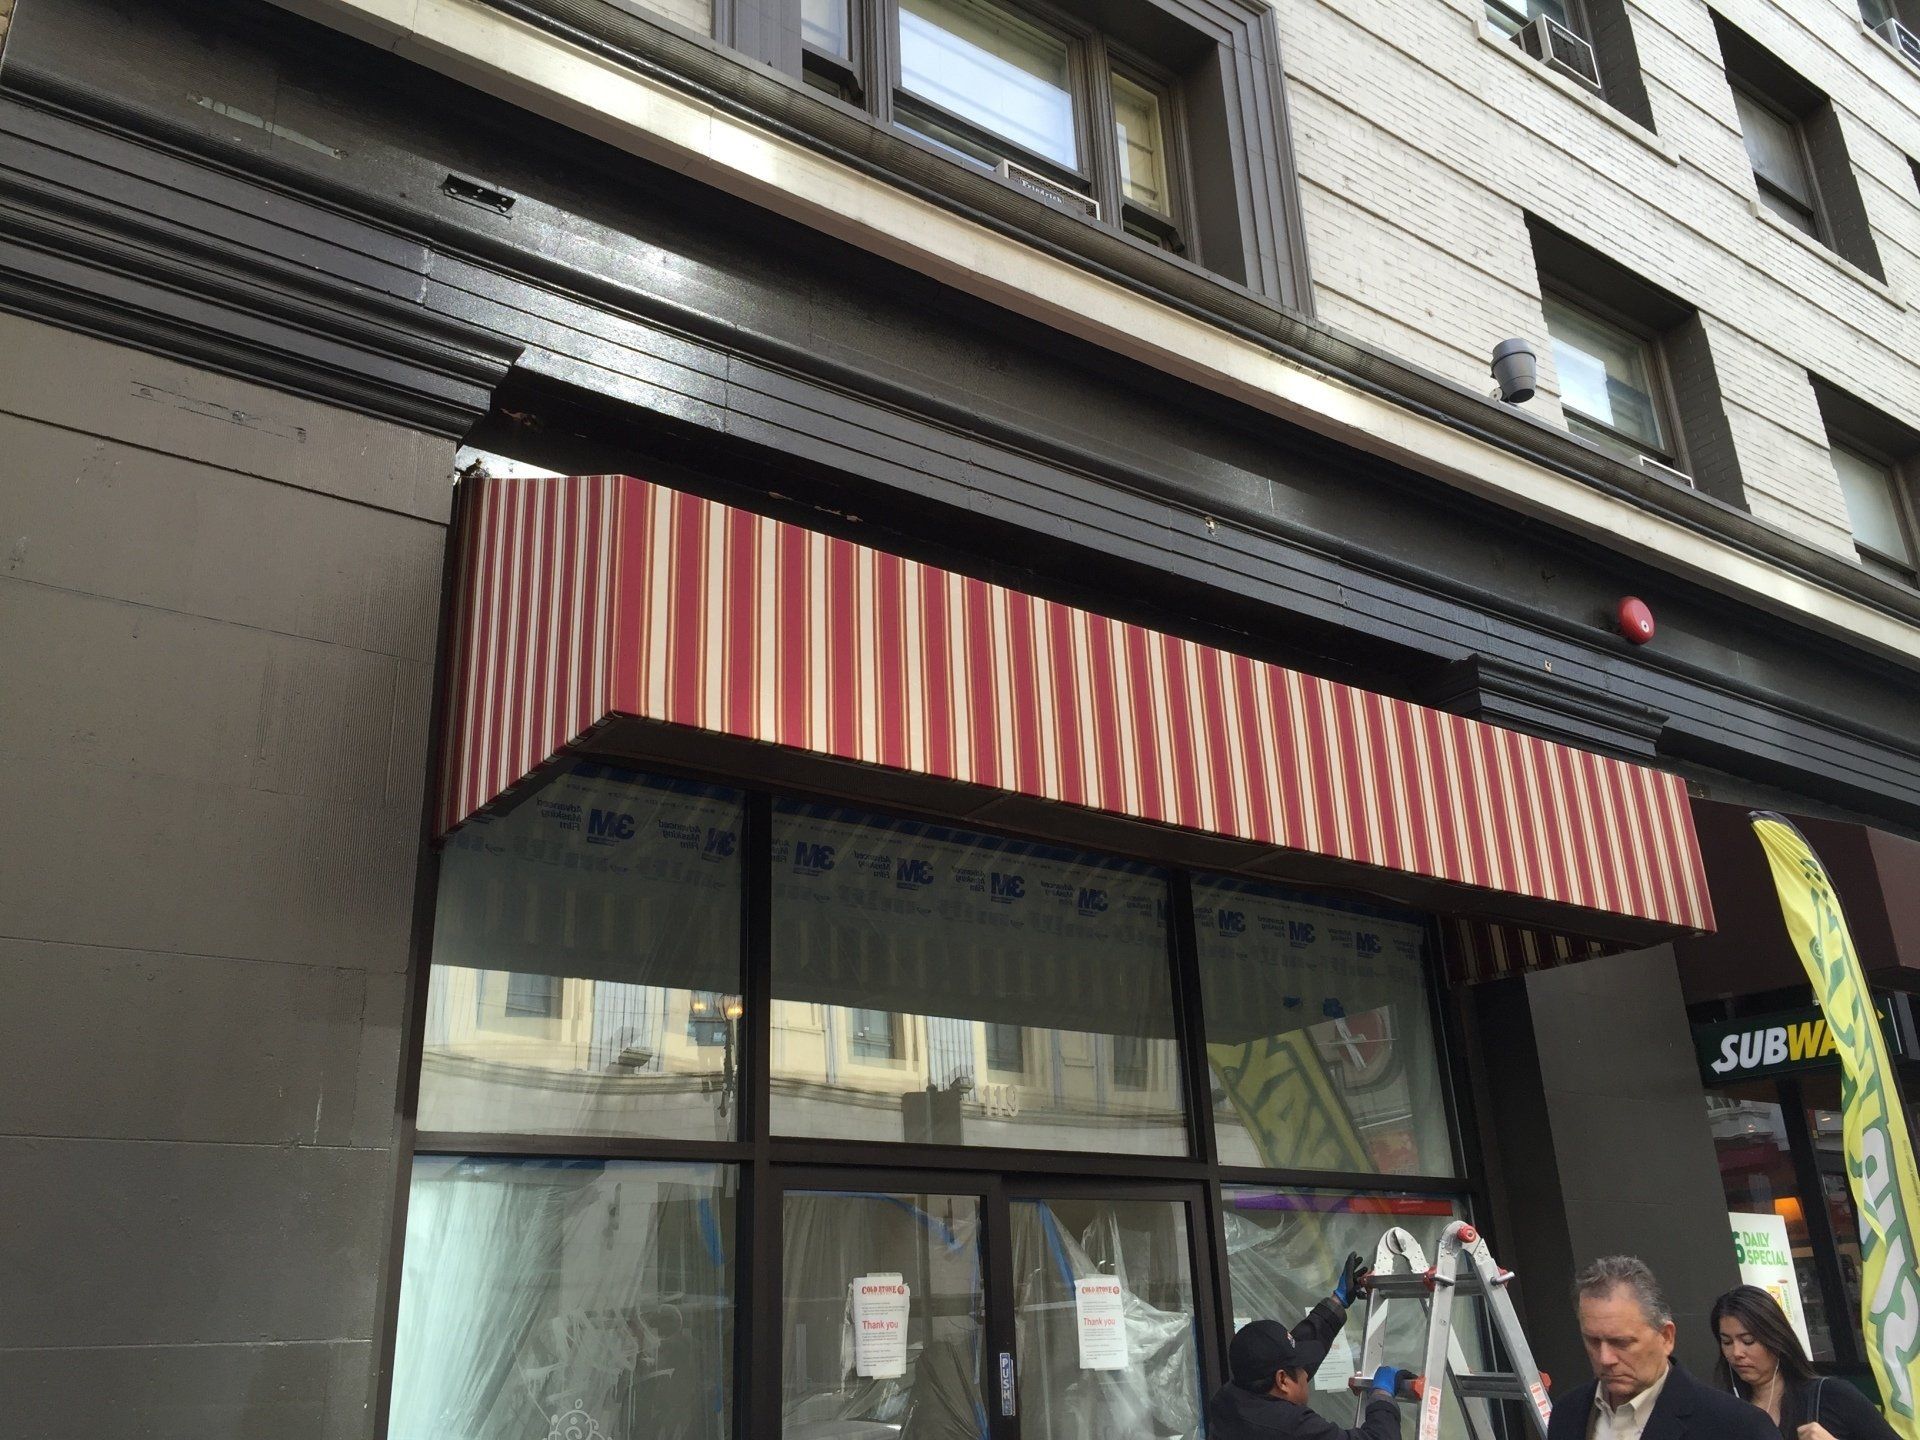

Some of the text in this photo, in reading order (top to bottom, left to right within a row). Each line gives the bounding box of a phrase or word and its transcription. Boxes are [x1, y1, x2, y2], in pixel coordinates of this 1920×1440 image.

[1711, 1018, 1840, 1075] SUBWA
[1743, 1231, 1770, 1248] DAILY
[1746, 1249, 1789, 1266] SPECIAL
[862, 1320, 899, 1331] Thank you
[1083, 1317, 1116, 1327] Thank you
[1002, 1357, 1010, 1400] PUSH
